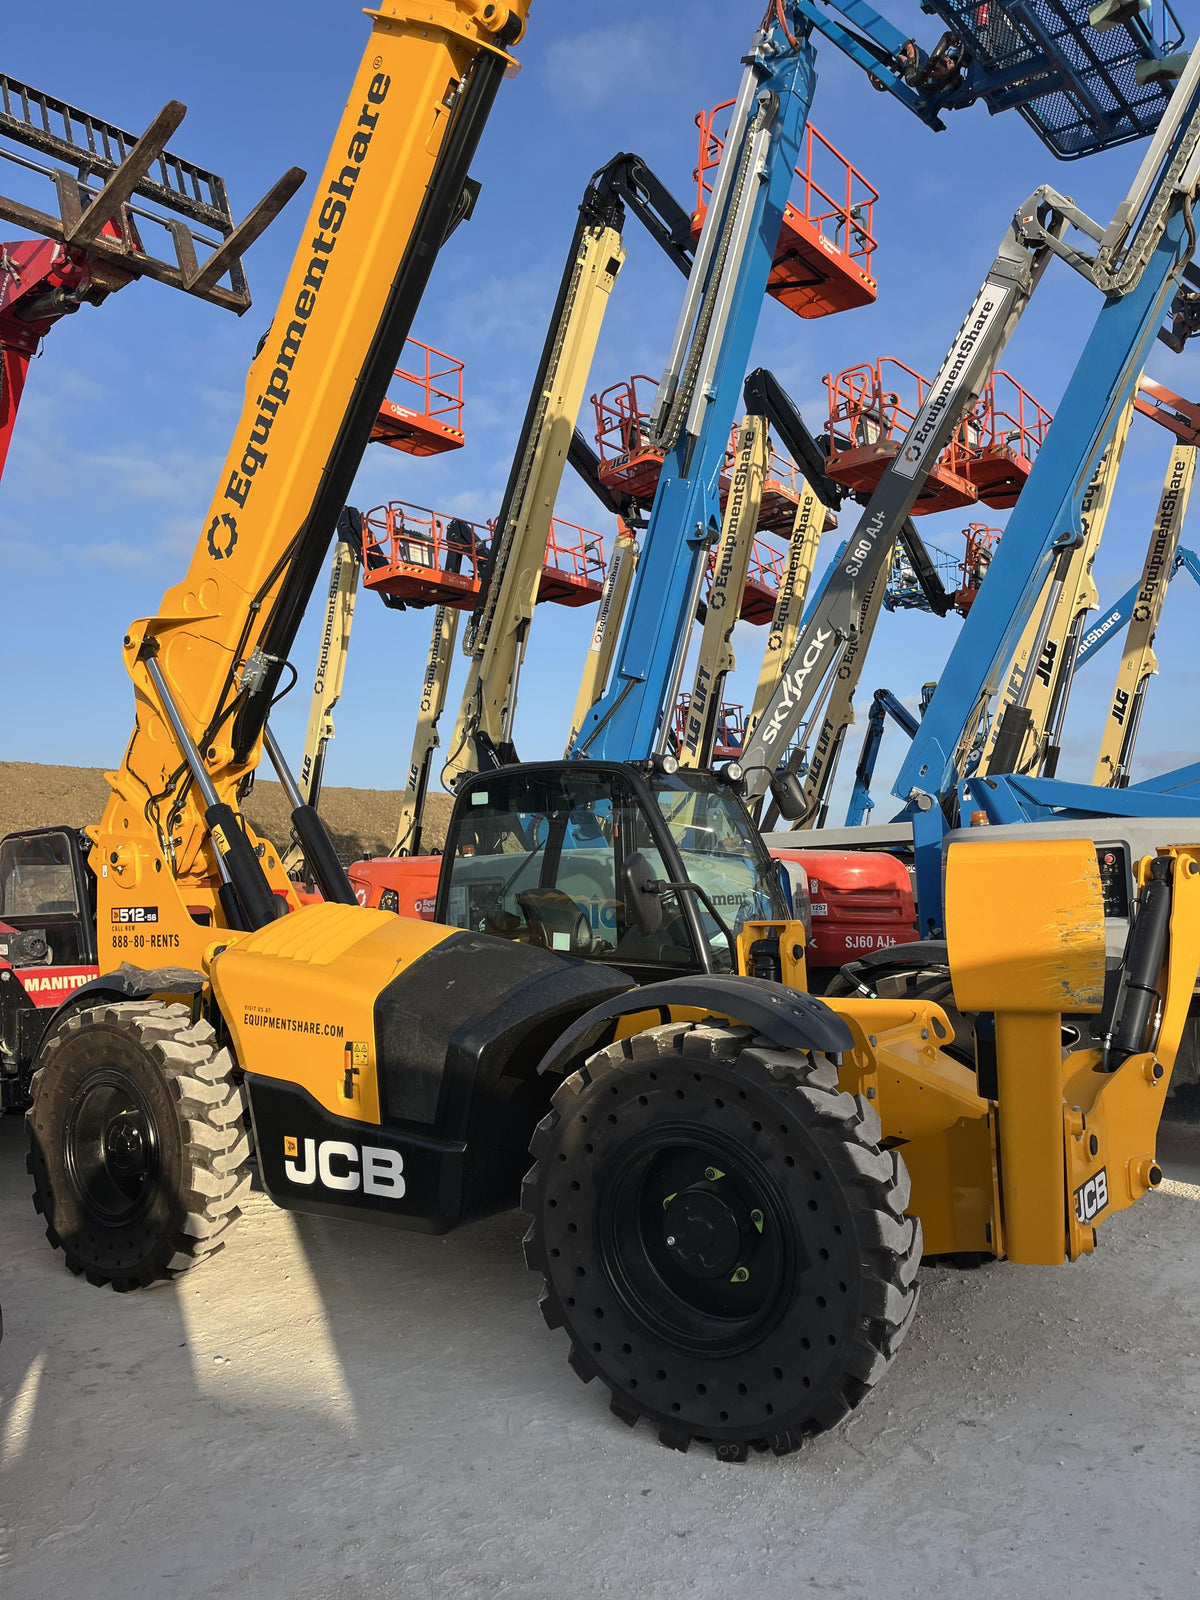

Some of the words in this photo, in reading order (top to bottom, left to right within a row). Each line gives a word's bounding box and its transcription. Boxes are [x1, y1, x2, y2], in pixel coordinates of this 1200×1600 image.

[914, 300, 994, 444] EquipmentShare
[610, 453, 630, 470] JLG
[715, 431, 755, 588] EquipmentShare
[1139, 461, 1186, 602] EquipmentShare
[772, 496, 813, 632] EquipmentShare
[845, 539, 872, 577] SJ60
[866, 510, 886, 540] AJ+
[317, 556, 342, 678] EquipmentShare
[597, 555, 620, 633] EquipmentShare
[423, 604, 446, 697] EquipmentSha
[1036, 639, 1059, 687] JLG
[693, 665, 712, 715] LIFT
[763, 627, 832, 744] SKYJACK
[1111, 688, 1129, 726] JLG
[685, 716, 702, 757] JLG
[808, 761, 823, 787] JLG
[817, 719, 834, 755] LIFT
[301, 754, 312, 786] JLG
[408, 764, 419, 792] JLG
[112, 934, 180, 948] 888-80-RENTS
[845, 936, 873, 948] SJ60
[876, 936, 896, 947] AJ+
[244, 1013, 344, 1038] EQUIPMENTSHARE.COM
[284, 1137, 406, 1199] JCB
[1076, 1171, 1108, 1222] JCB
